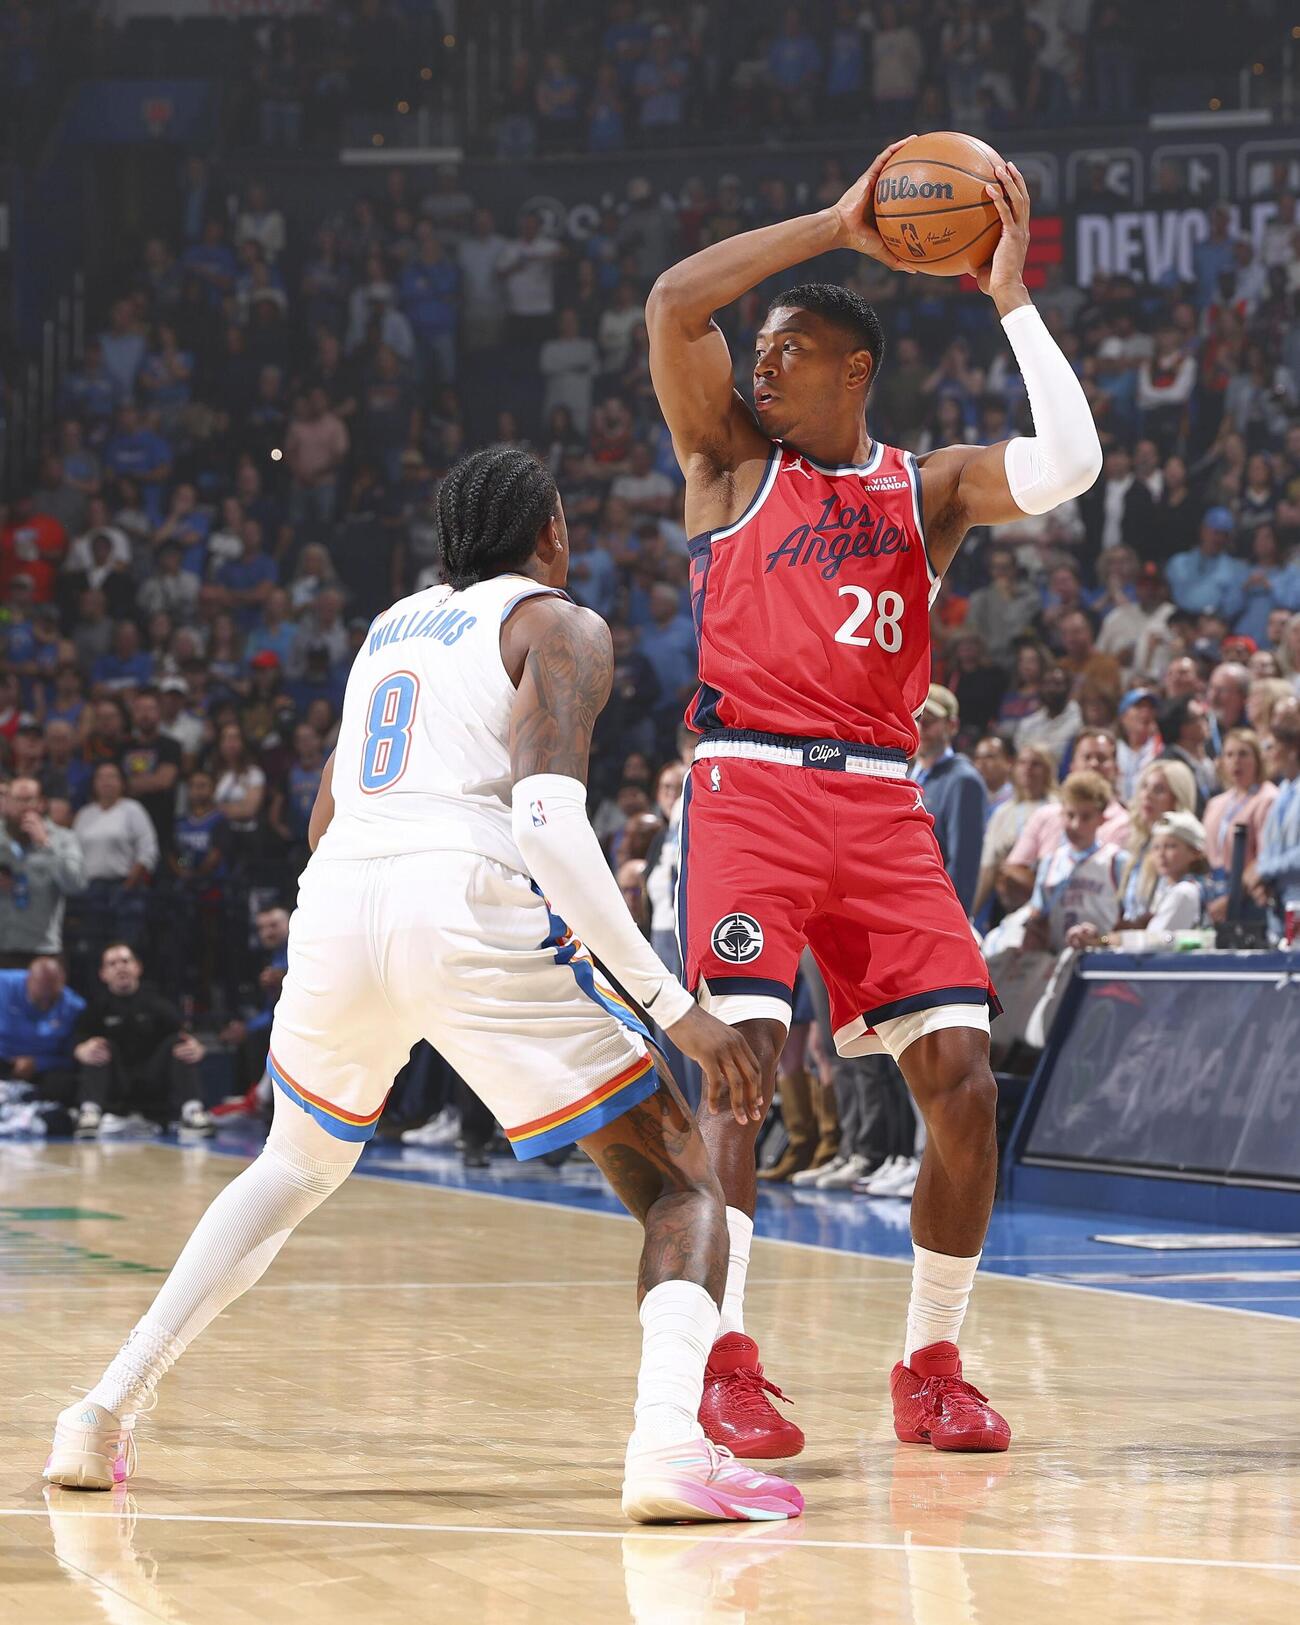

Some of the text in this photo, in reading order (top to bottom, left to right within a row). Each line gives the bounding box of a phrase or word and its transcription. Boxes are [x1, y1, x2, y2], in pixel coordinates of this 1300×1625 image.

[876, 175, 955, 205] Wilson
[864, 480, 909, 492] RWANDA
[871, 475, 897, 485] VISIT
[813, 494, 875, 532] Los
[368, 607, 478, 656] WILLIAMS
[834, 585, 905, 654] 28
[359, 669, 421, 796] 8
[809, 744, 841, 763] Clips
